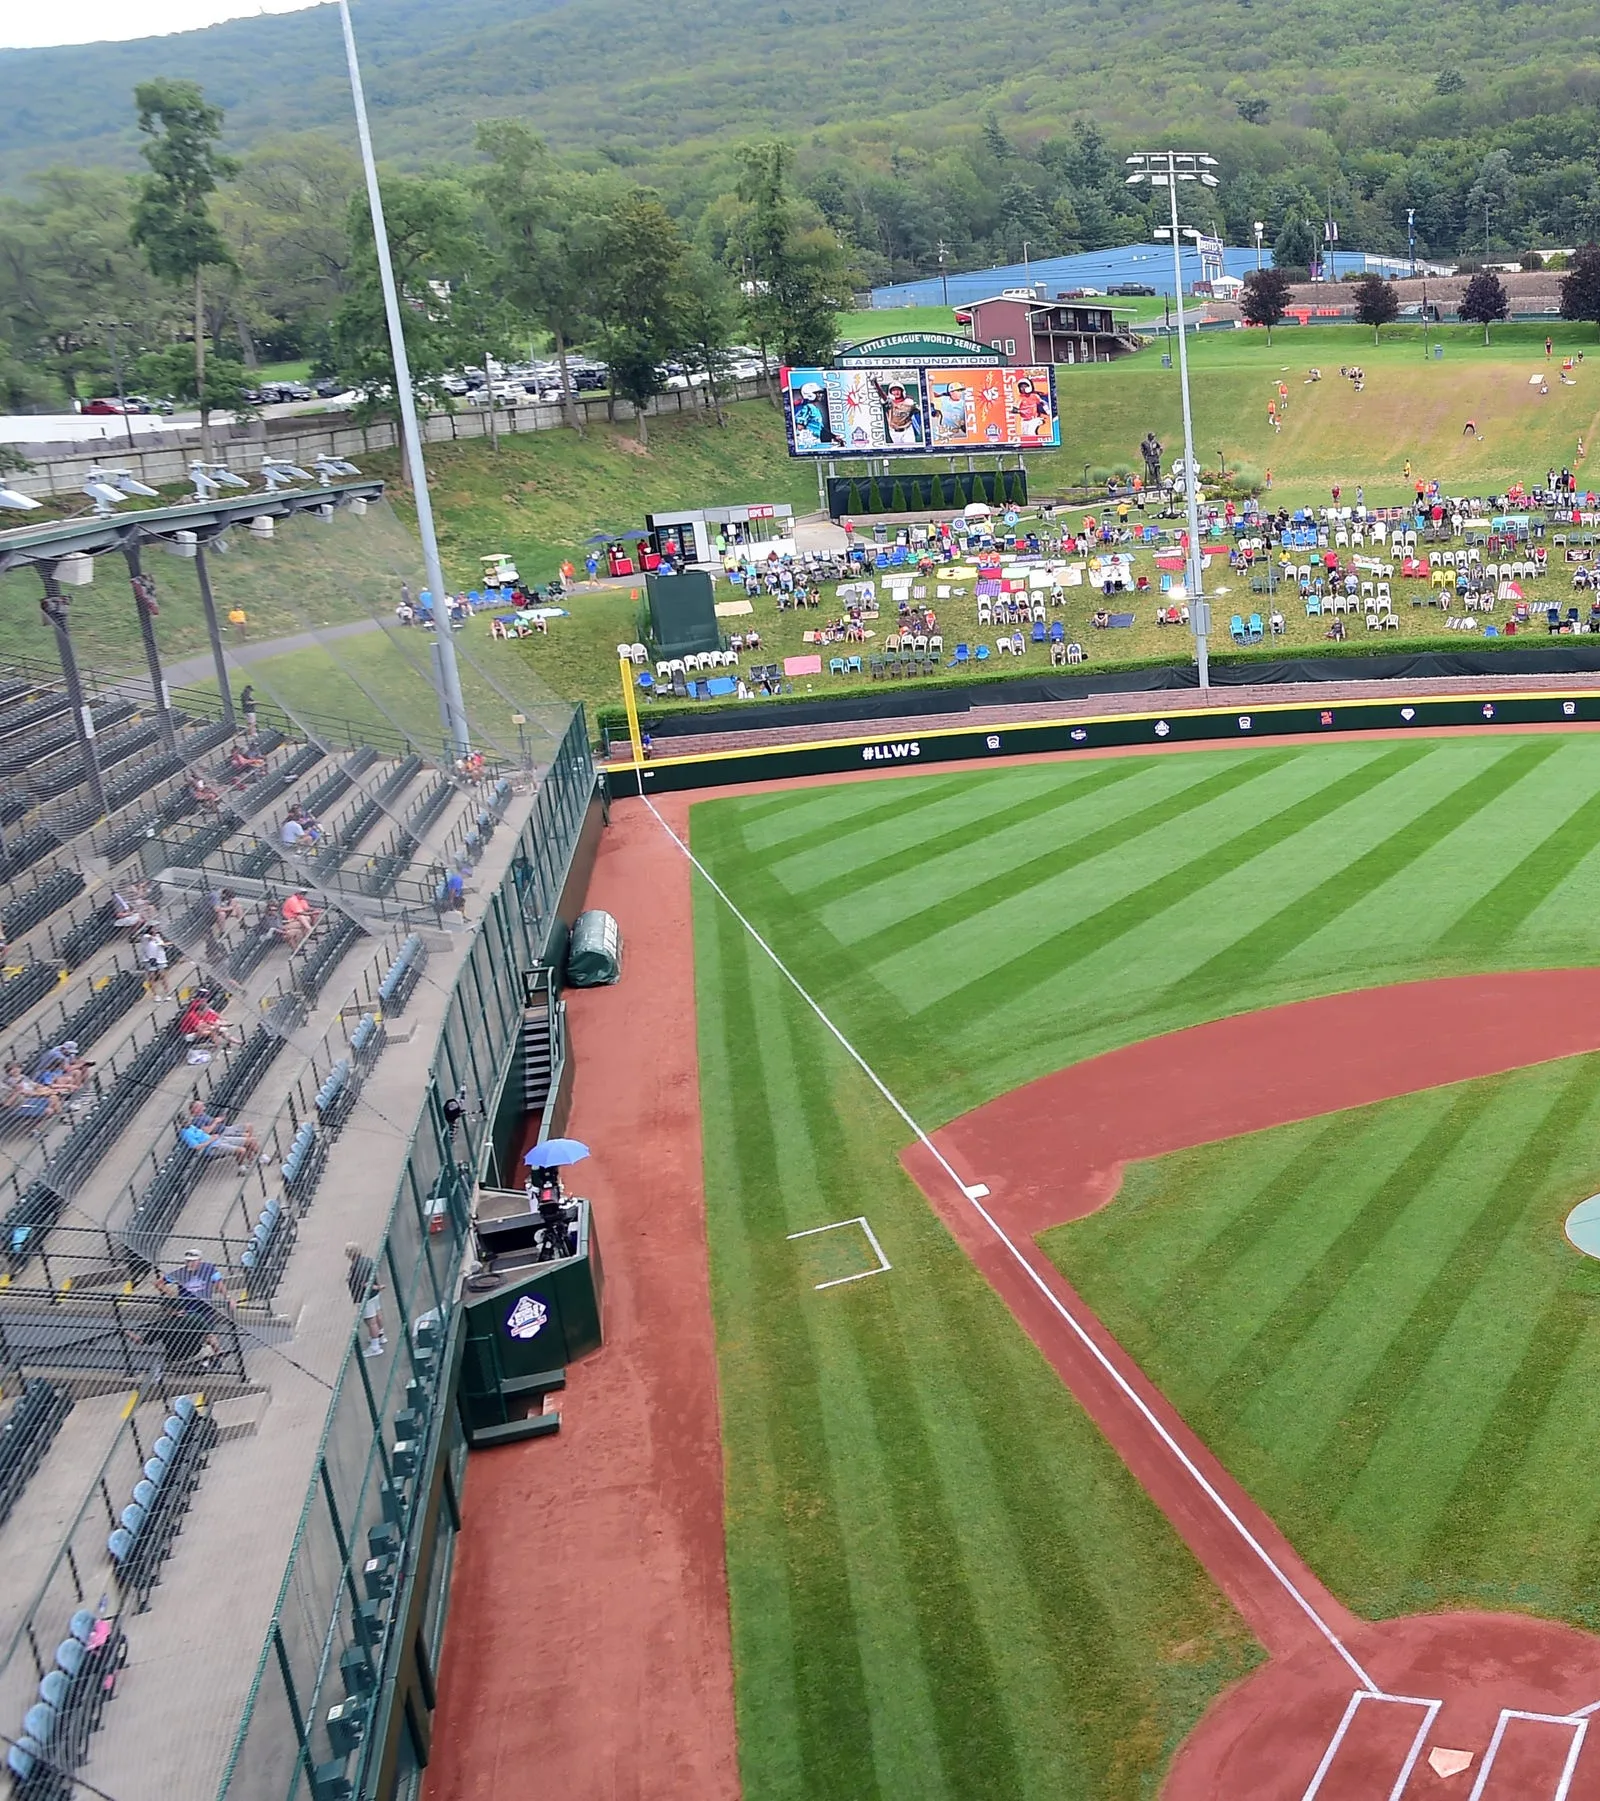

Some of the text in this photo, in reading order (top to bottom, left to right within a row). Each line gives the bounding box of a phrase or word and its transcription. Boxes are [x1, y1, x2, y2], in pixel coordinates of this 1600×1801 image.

[859, 334, 982, 355] LITTLE LEAGUE WORLD SERIES
[845, 357, 997, 366] EASTON FOUNDATIONS
[983, 386, 999, 401] VS
[965, 386, 978, 434] WEST
[862, 742, 921, 761] #LLWS
